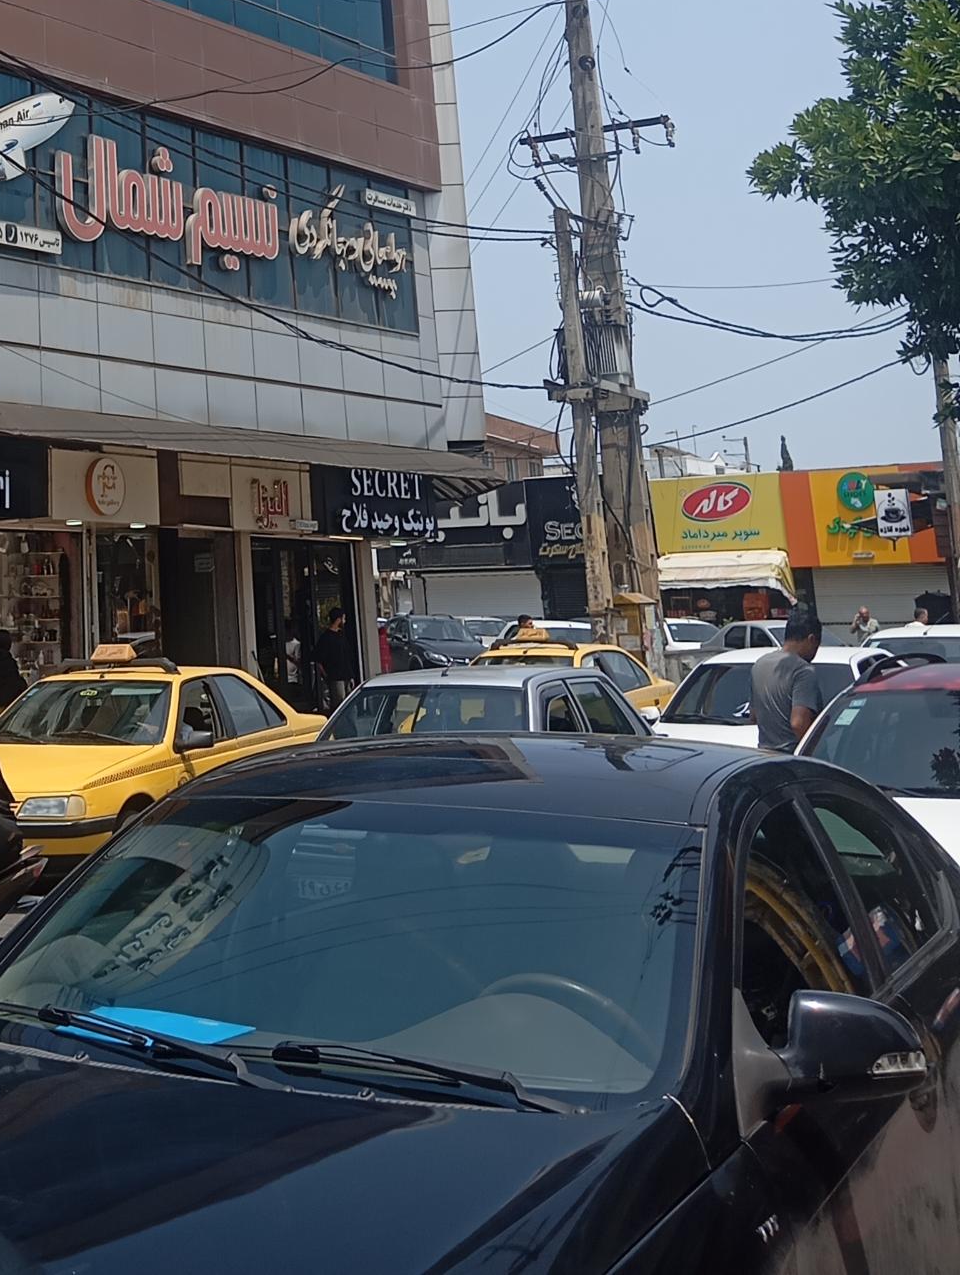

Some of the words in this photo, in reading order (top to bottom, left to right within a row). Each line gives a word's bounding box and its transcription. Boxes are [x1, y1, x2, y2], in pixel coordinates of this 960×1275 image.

[16, 108, 30, 123] Air
[55, 134, 184, 243] شمال
[19, 231, 39, 244] ۱۳۷۶
[186, 184, 281, 271] نسیم
[351, 468, 423, 500] SECRET
[692, 487, 740, 517] کاله
[341, 502, 369, 533] فلاح
[371, 508, 400, 537] وحید
[682, 528, 728, 541] میرداماد
[732, 529, 760, 541] سوپر
